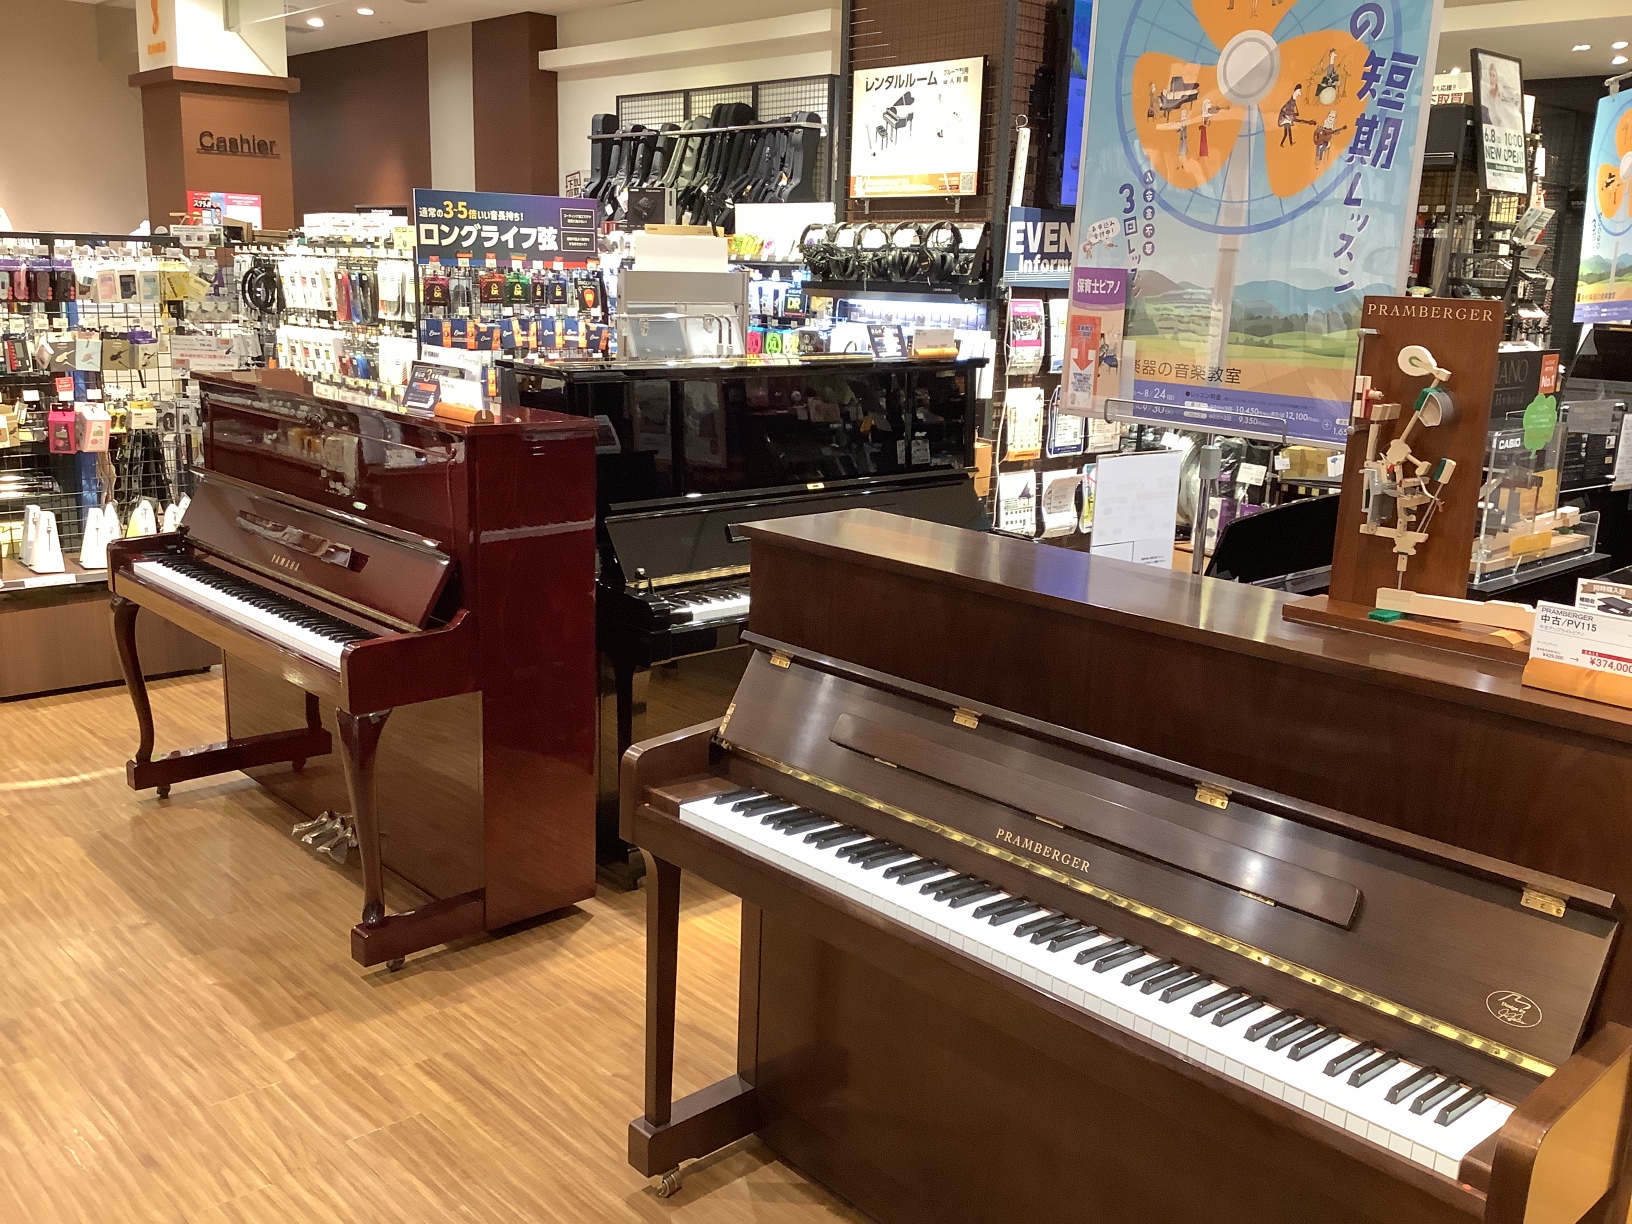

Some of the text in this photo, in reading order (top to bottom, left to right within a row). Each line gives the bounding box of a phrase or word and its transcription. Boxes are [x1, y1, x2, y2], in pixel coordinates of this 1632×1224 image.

[865, 71, 938, 92] レンタルルーム
[199, 131, 276, 154] Cashier
[1485, 145, 1502, 160] NEW
[419, 223, 558, 251] ロングライフ弦
[1077, 278, 1121, 294] 保育士ピアノ
[787, 297, 801, 309] DR
[1367, 303, 1493, 322] PRAMBERGER
[1541, 375, 1555, 387] No.1
[1498, 437, 1521, 450] CASIO
[270, 553, 301, 572] YAMAHA
[1540, 613, 1597, 632] 中古/PV115
[1541, 607, 1594, 622] PRAMBERGER
[995, 828, 1091, 873] PRAMBERGER
